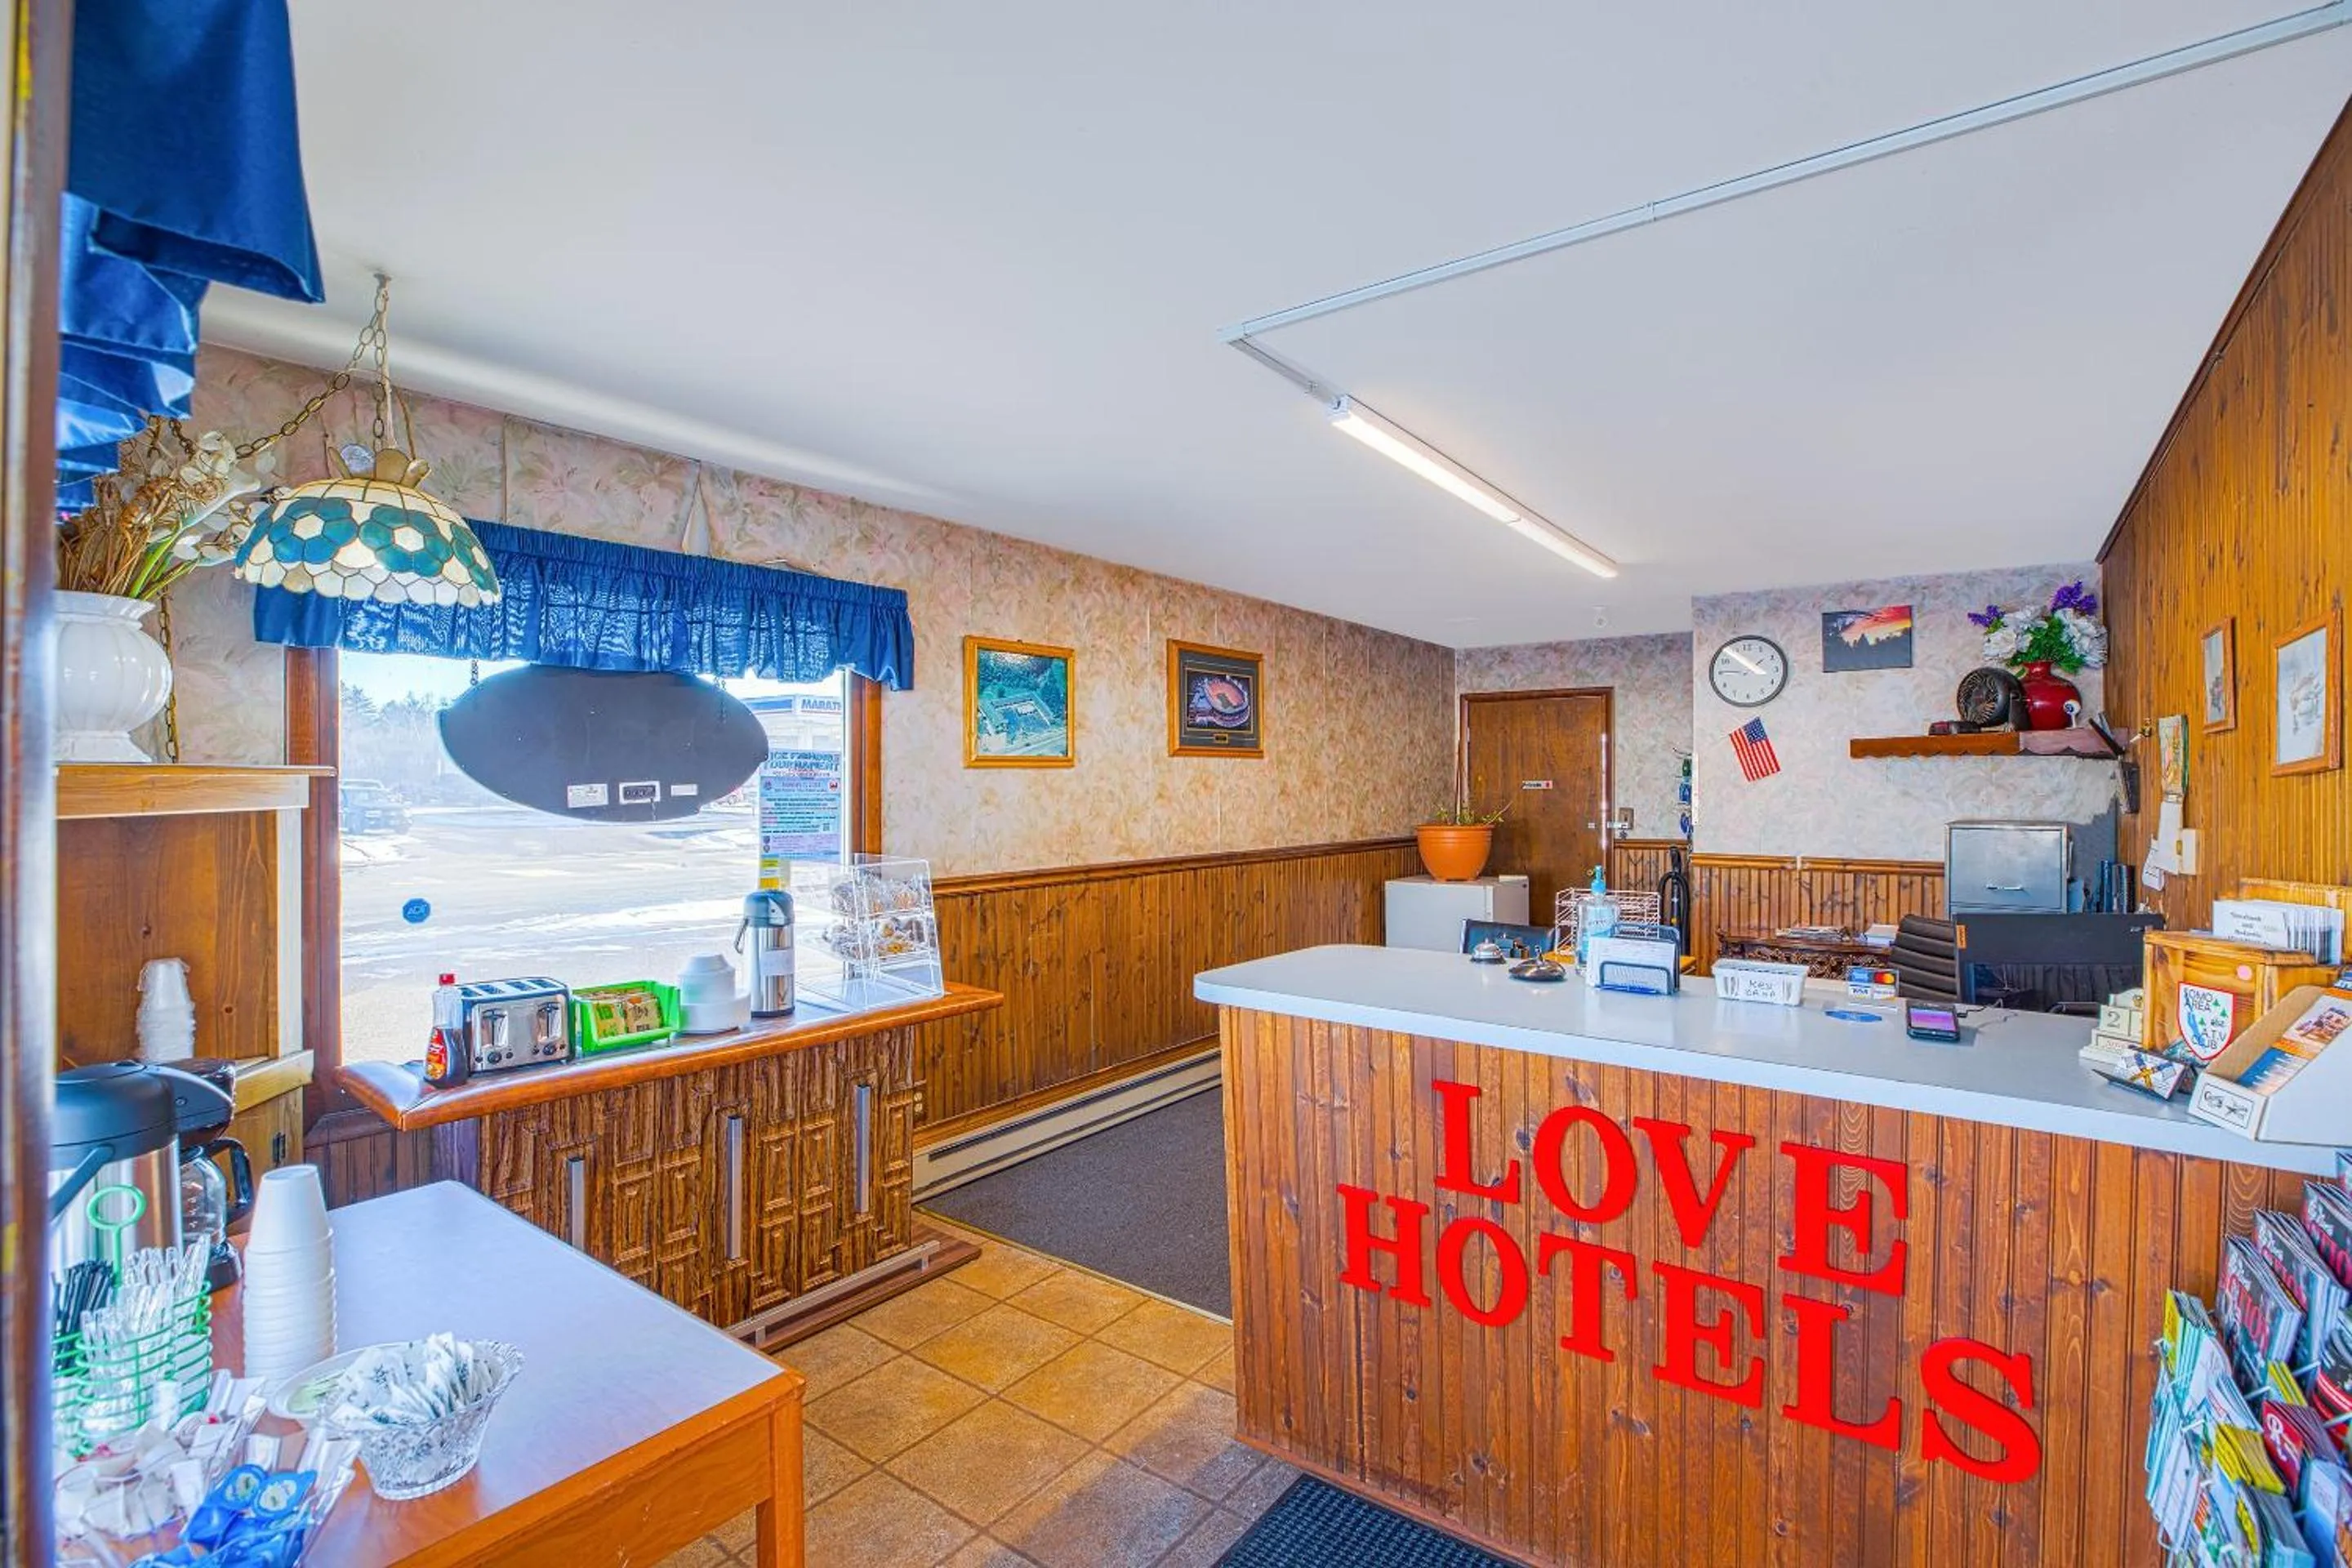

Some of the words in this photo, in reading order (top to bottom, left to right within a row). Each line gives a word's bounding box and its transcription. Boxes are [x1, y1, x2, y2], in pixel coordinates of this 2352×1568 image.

[2107, 1011, 2121, 1029] 2
[1432, 1079, 1908, 1296] LOVE
[1337, 1182, 2041, 1484] HOTELS
